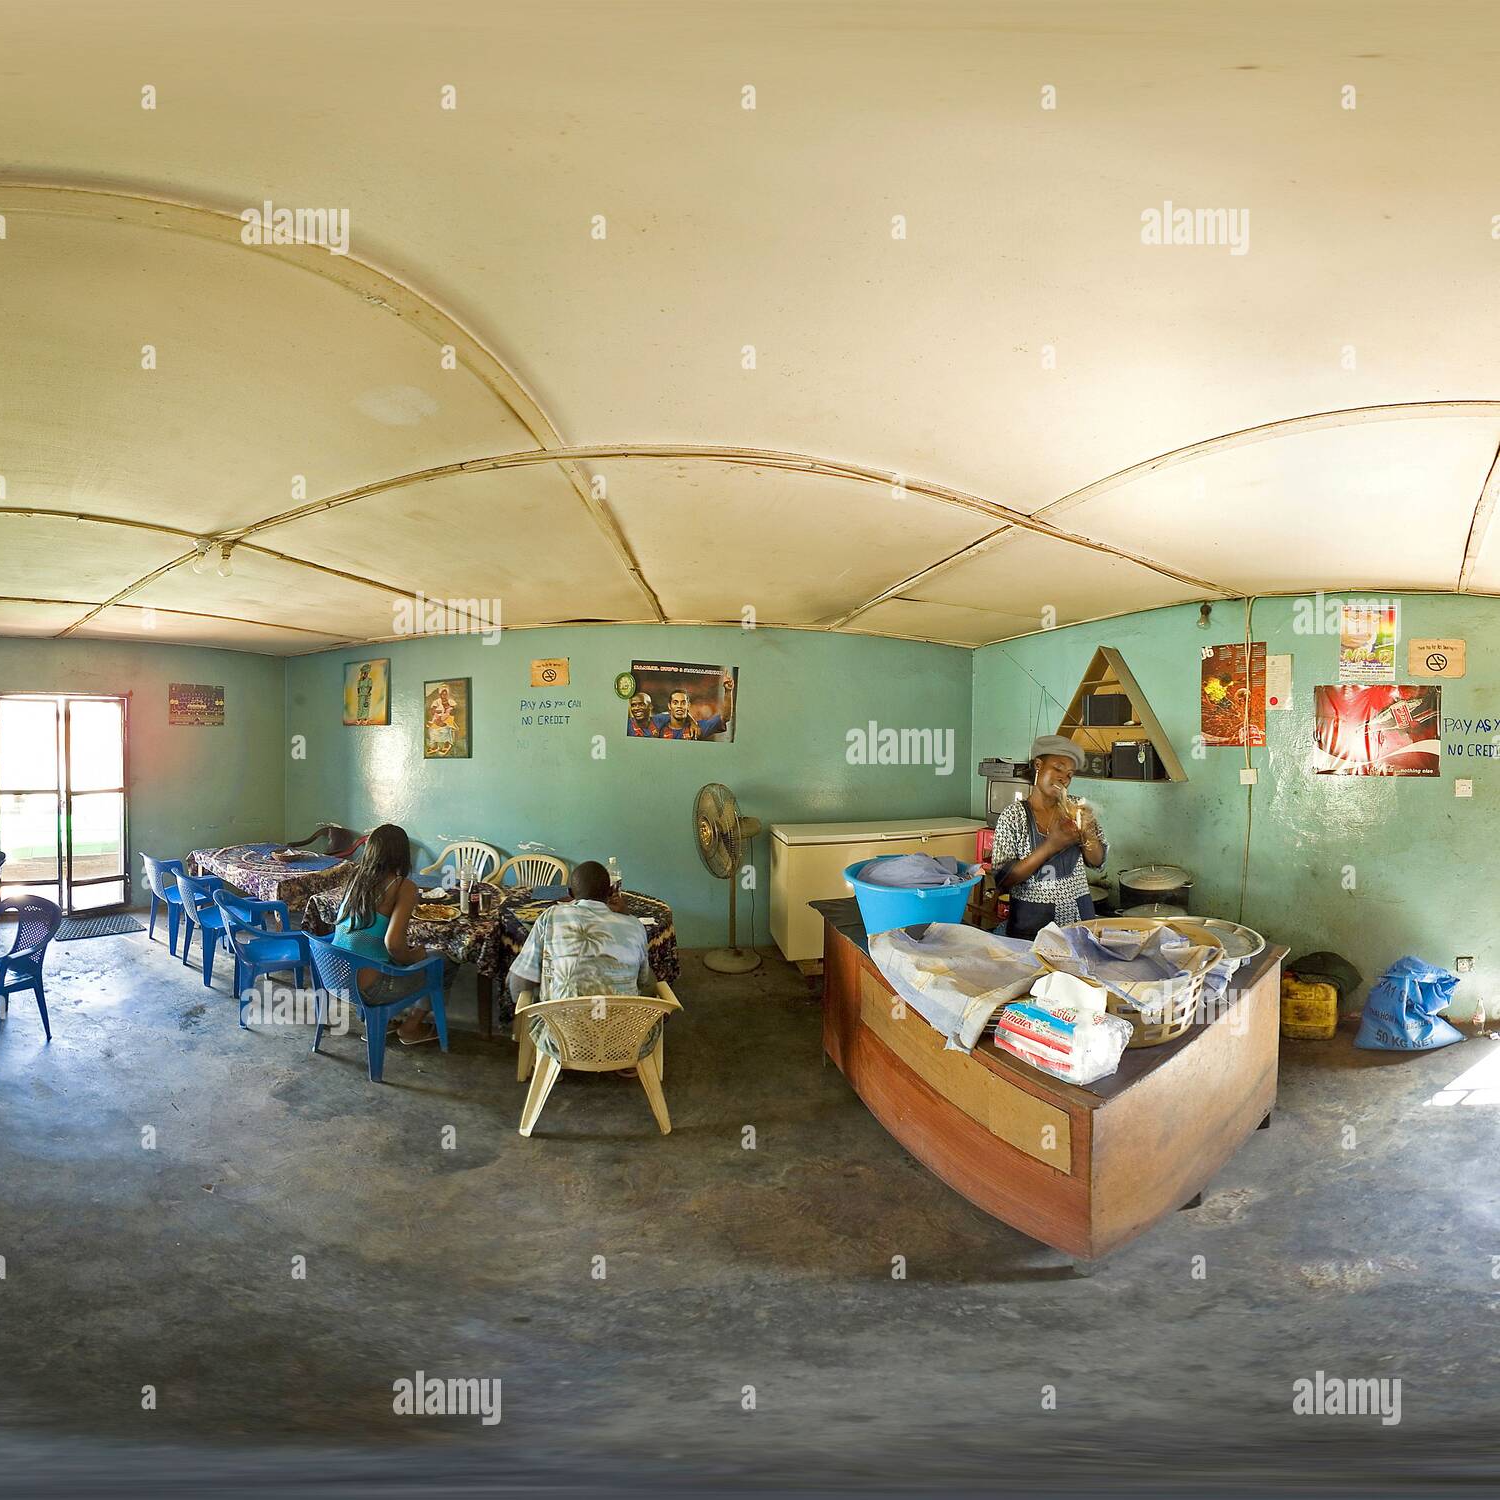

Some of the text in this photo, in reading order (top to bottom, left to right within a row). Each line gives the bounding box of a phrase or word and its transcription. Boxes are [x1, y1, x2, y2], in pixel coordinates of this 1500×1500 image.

[520, 700, 536, 711] PAY
[539, 700, 551, 709] AS
[522, 715, 570, 725] NO CREDIT
[1444, 718, 1472, 735] PAY
[1475, 718, 1491, 733] AS
[1447, 744, 1463, 756] NO
[1375, 1029, 1435, 1048] 50 KG NET
